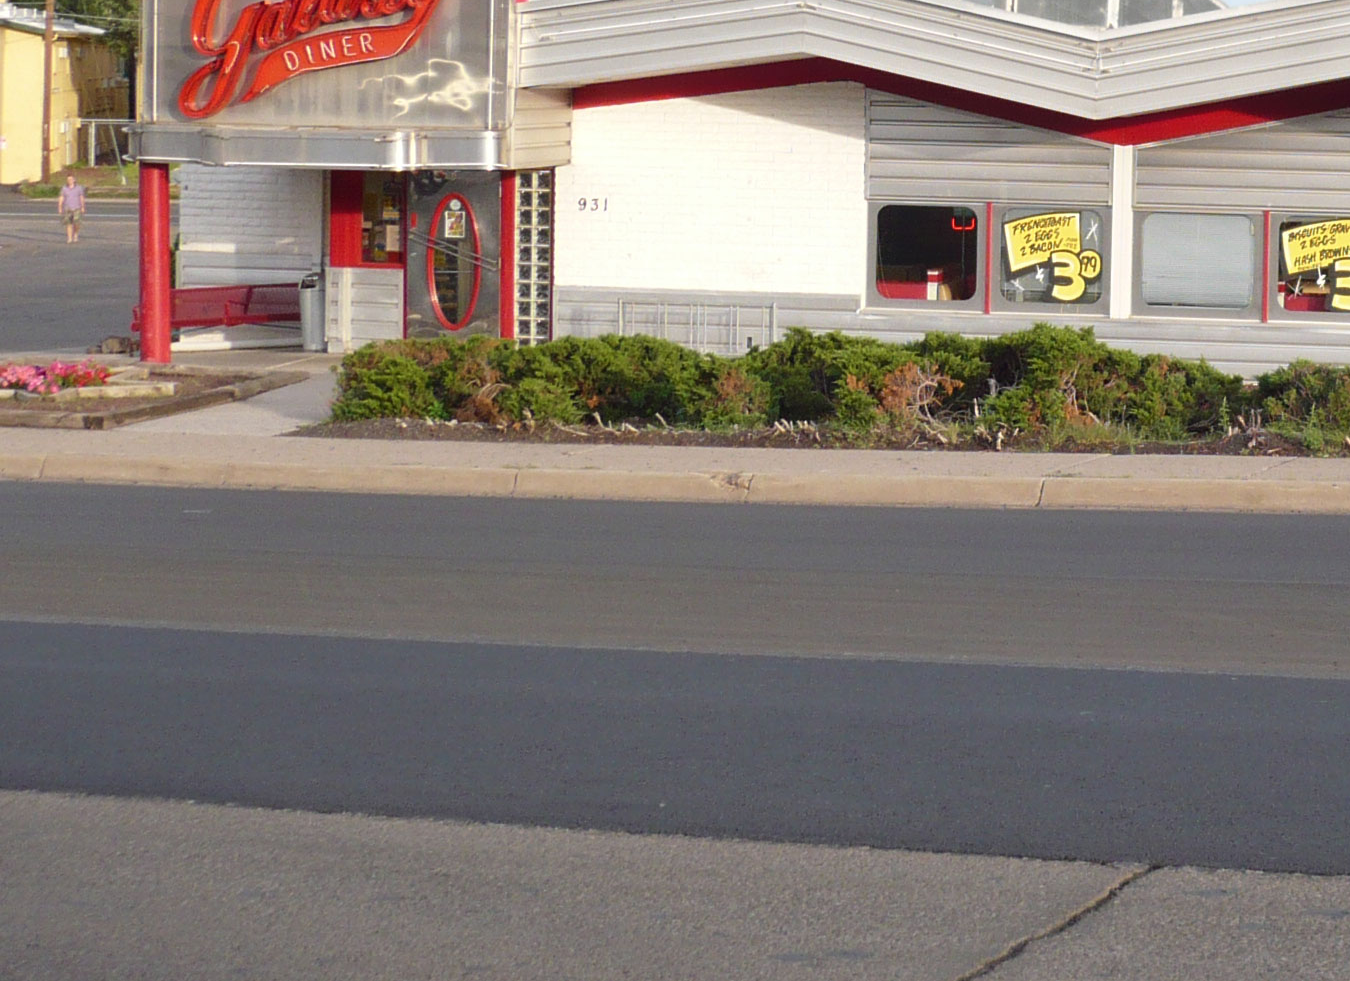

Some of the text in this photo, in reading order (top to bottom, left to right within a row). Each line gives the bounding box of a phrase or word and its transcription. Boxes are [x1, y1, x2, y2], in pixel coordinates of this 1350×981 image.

[283, 33, 377, 71] DINER
[578, 197, 608, 211] 931
[1024, 228, 1060, 244] 2 EGGS
[1288, 224, 1327, 242] BISCUITS
[1020, 246, 1027, 256] 2
[1028, 238, 1063, 255] BACON
[1300, 235, 1336, 250] 2 EGGS
[1294, 250, 1316, 267] HASH
[1051, 250, 1085, 300] 3
